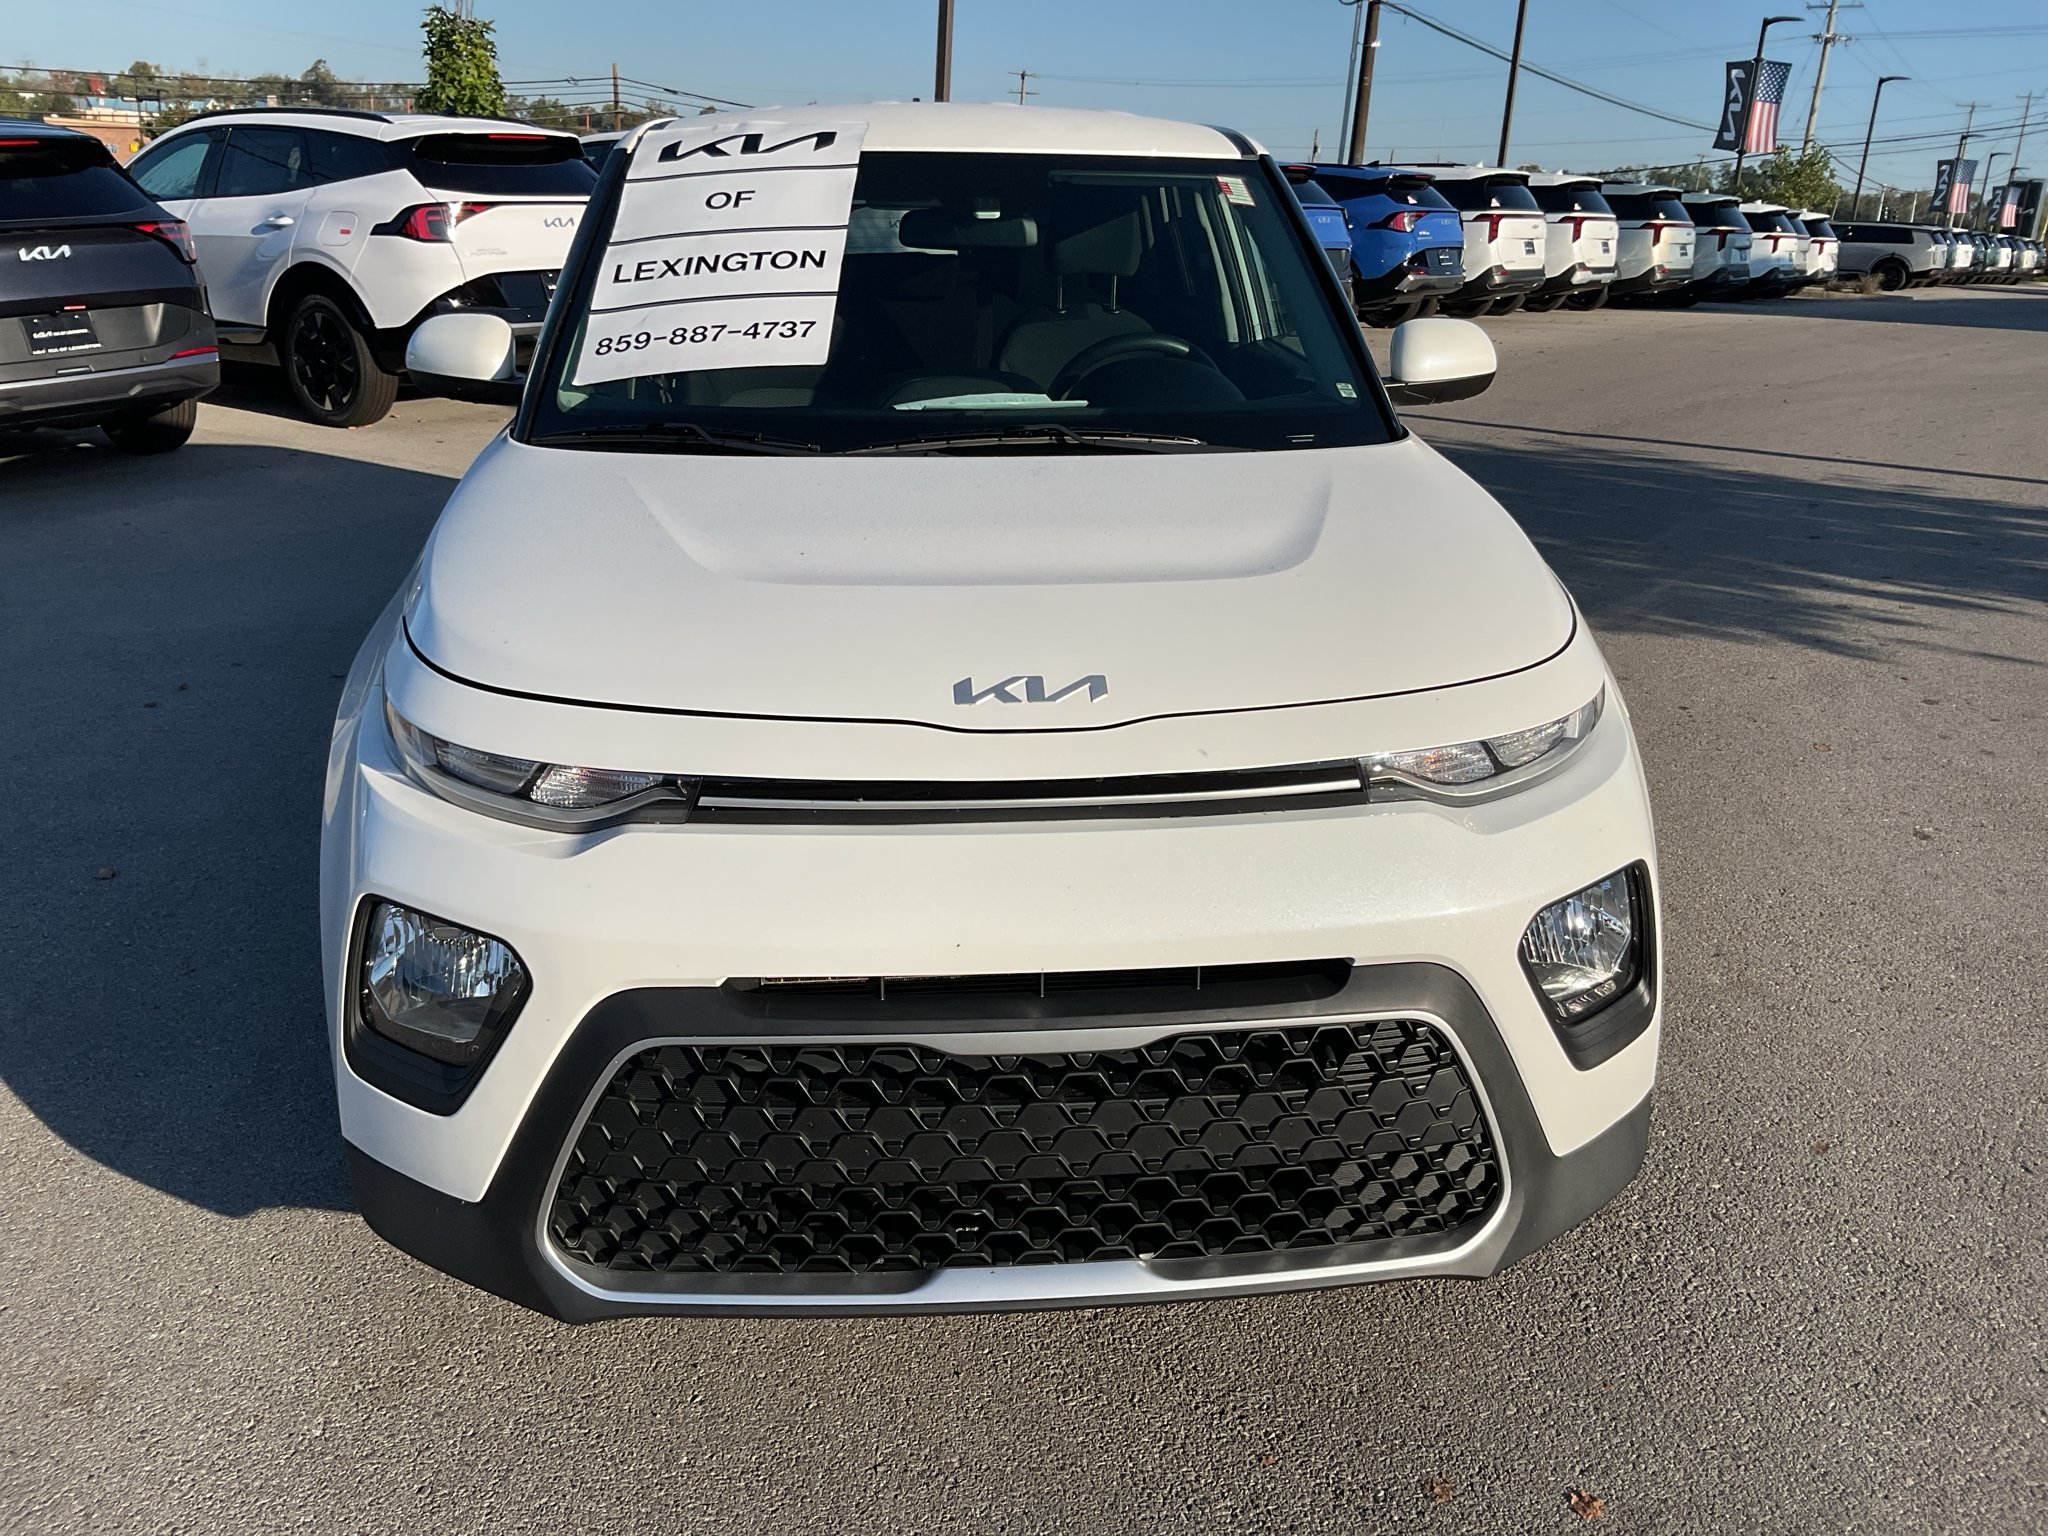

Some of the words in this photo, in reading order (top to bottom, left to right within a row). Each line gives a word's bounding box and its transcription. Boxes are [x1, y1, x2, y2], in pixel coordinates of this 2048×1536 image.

[1723, 69, 1746, 141] KIA
[658, 131, 837, 163] KIA
[705, 190, 756, 209] OF
[544, 217, 575, 227] KIA
[19, 245, 71, 261] KIA
[612, 250, 827, 284] LEXINGTON
[595, 320, 817, 356] 859-887-4737
[953, 675, 1108, 705] KIA
